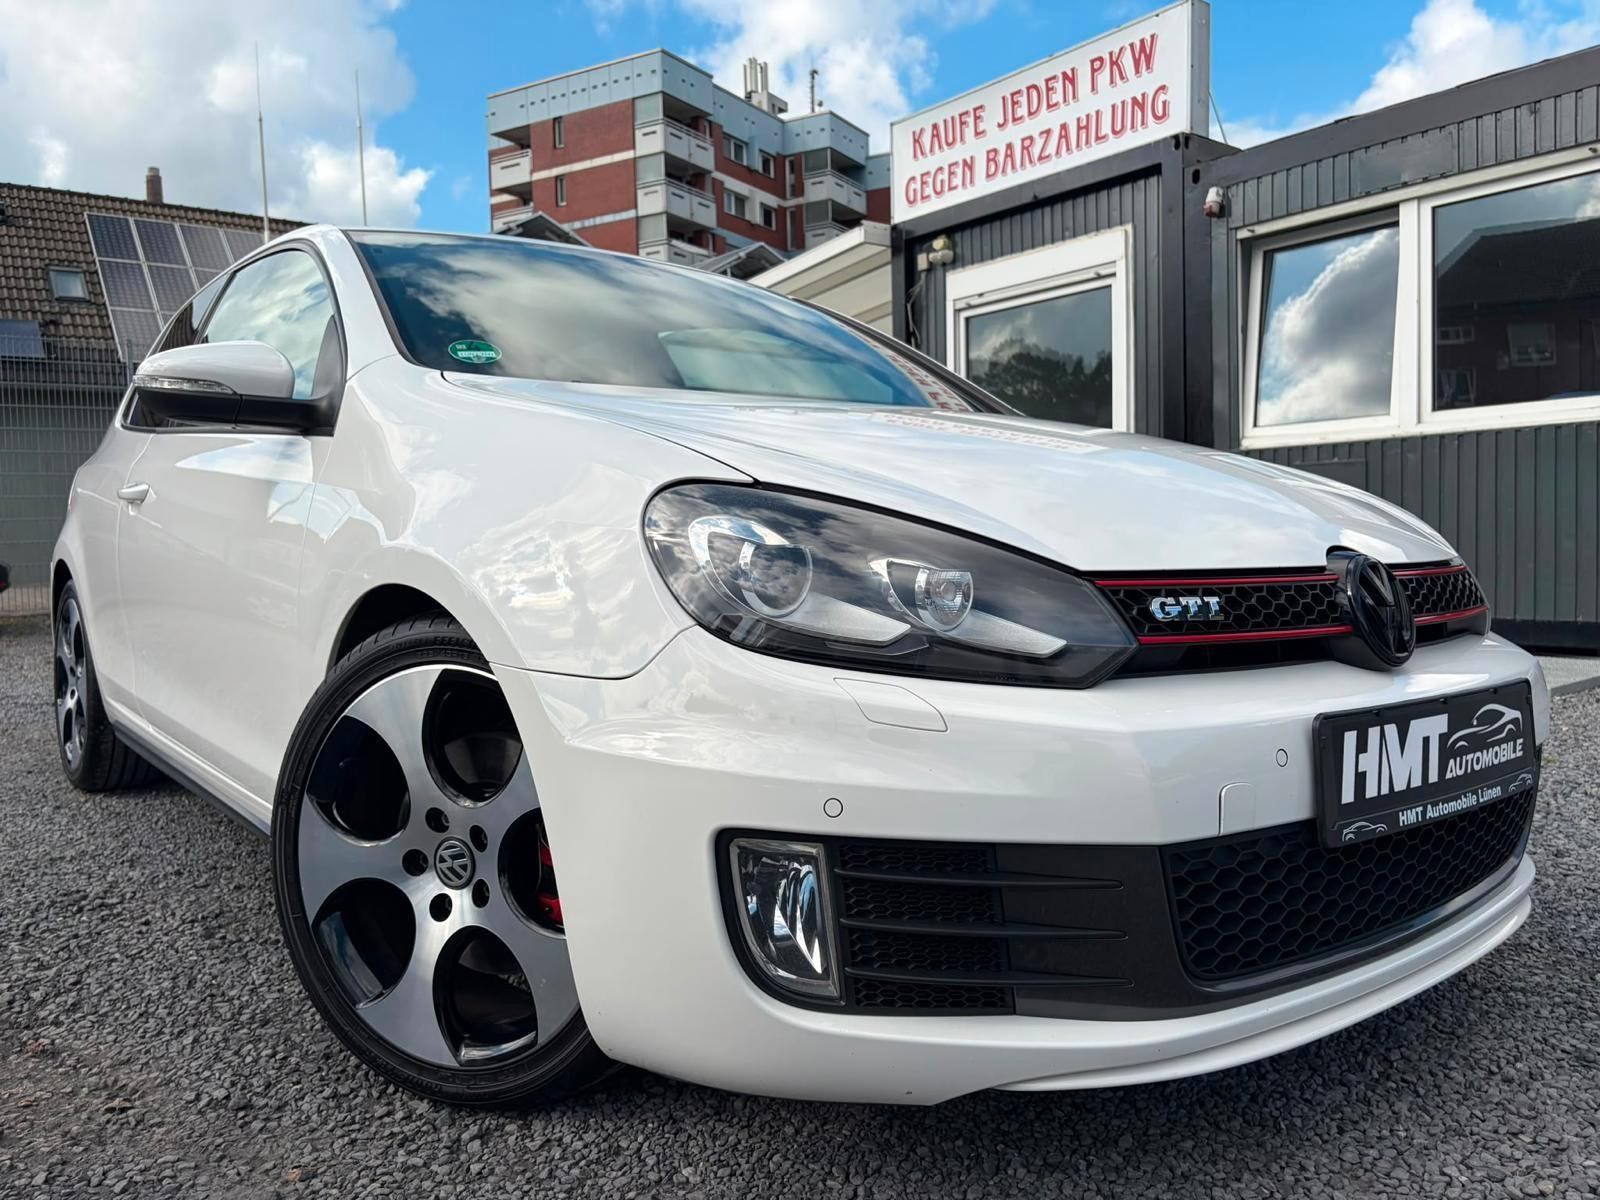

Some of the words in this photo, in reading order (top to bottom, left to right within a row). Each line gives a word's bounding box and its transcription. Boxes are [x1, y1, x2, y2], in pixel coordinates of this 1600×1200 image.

[912, 104, 986, 160] KAUFE
[997, 66, 1079, 132] JEDEN
[1090, 32, 1158, 94] PKW
[905, 155, 975, 207] GEGEN
[985, 84, 1170, 181] BARZAHLUNG
[1150, 596, 1225, 621] GTI
[1341, 713, 1449, 805] HMT
[1445, 738, 1524, 780] AUTOMOBILE
[1399, 808, 1424, 827] HMT
[1426, 793, 1477, 820] Automobile
[1478, 784, 1502, 802] Lünen
